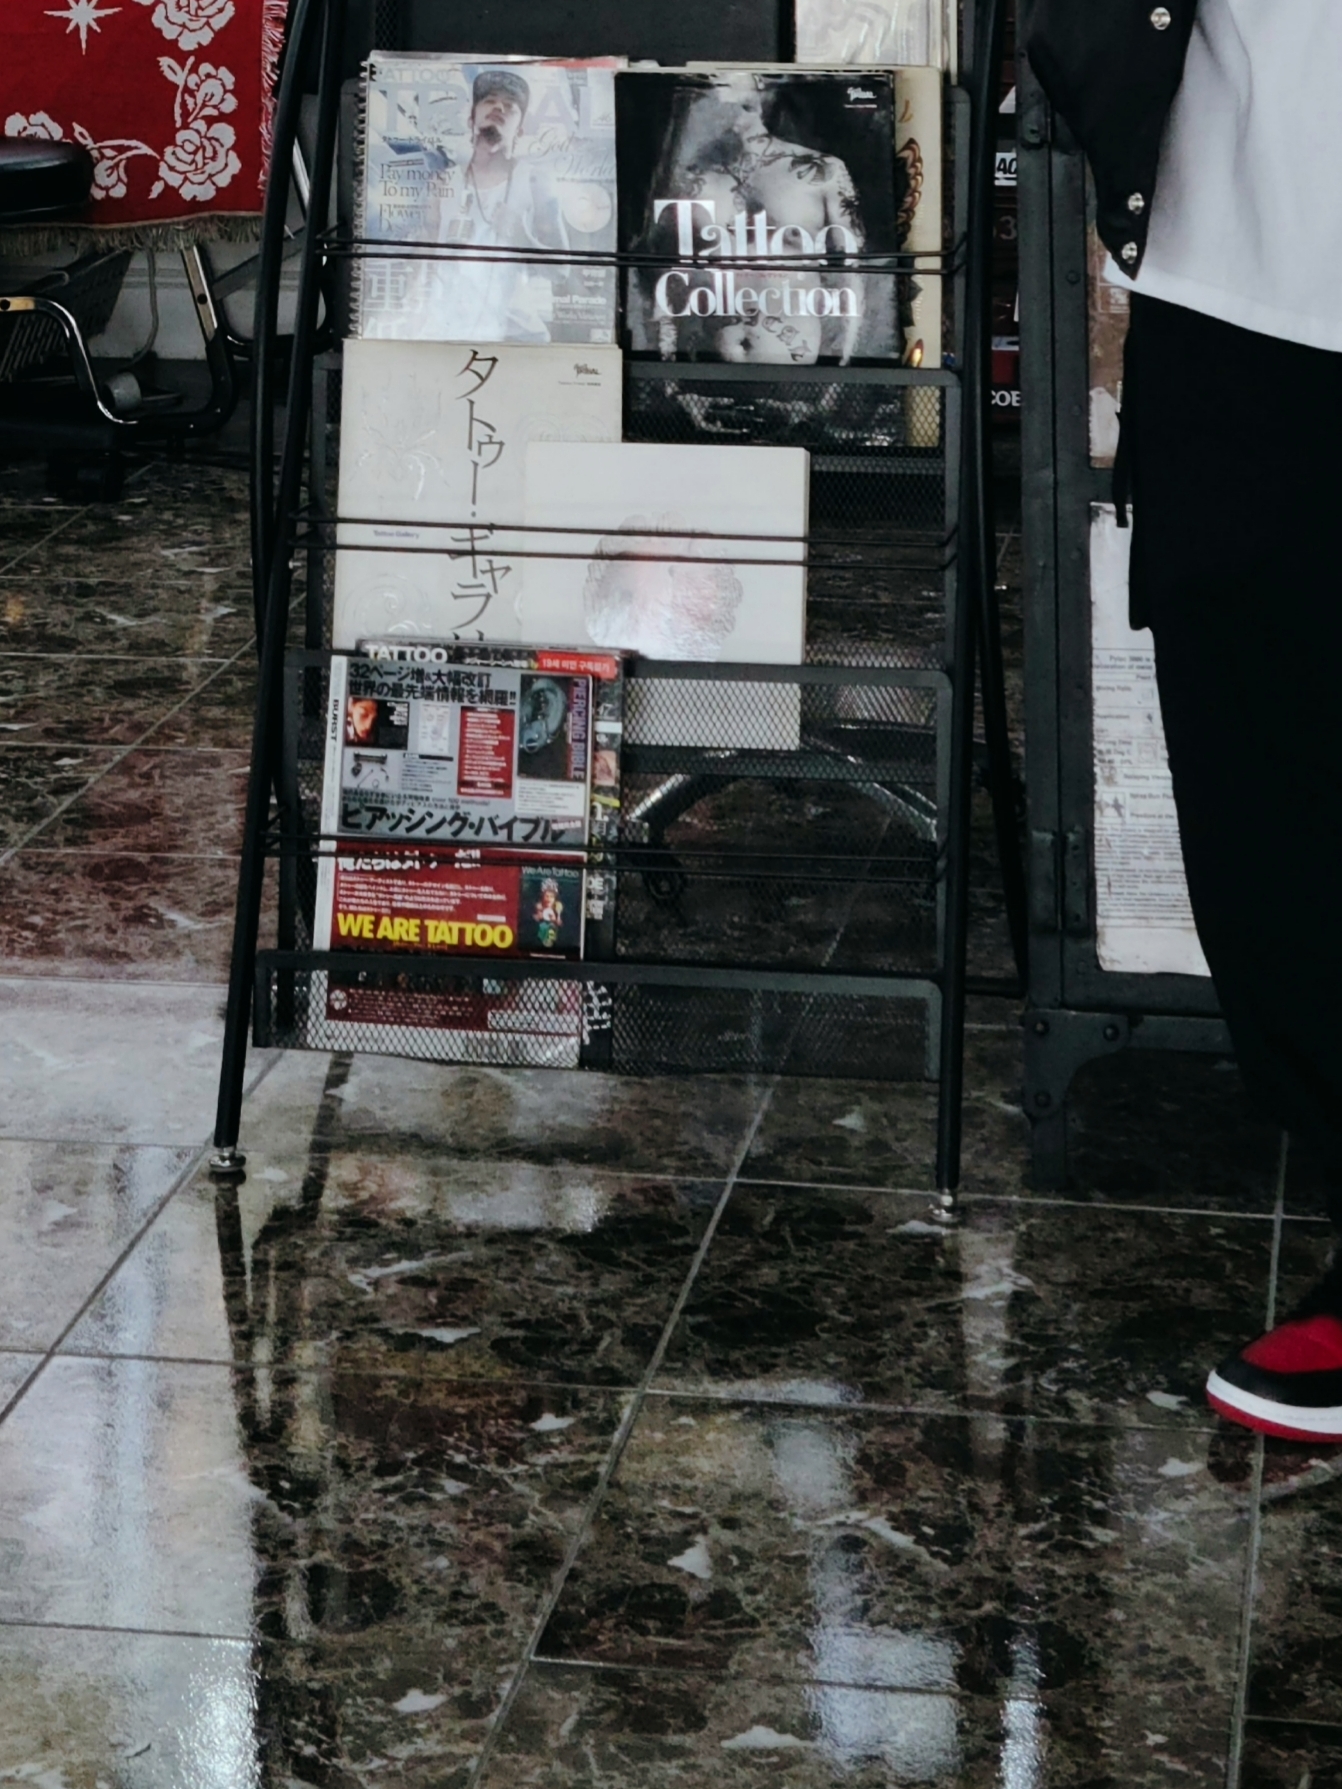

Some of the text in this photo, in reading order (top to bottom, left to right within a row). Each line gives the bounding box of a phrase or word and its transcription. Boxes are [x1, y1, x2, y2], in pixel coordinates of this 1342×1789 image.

[379, 164, 456, 183] Pay money
[380, 180, 455, 202] To my Pain
[653, 199, 860, 266] Tattoo
[654, 270, 861, 317] Collection
[449, 348, 512, 642] タトゥー・ギャラ
[364, 644, 448, 664] TATTOO
[571, 677, 589, 780] PIERCING BIBLE
[337, 912, 514, 949] WE ARE TATTOO
